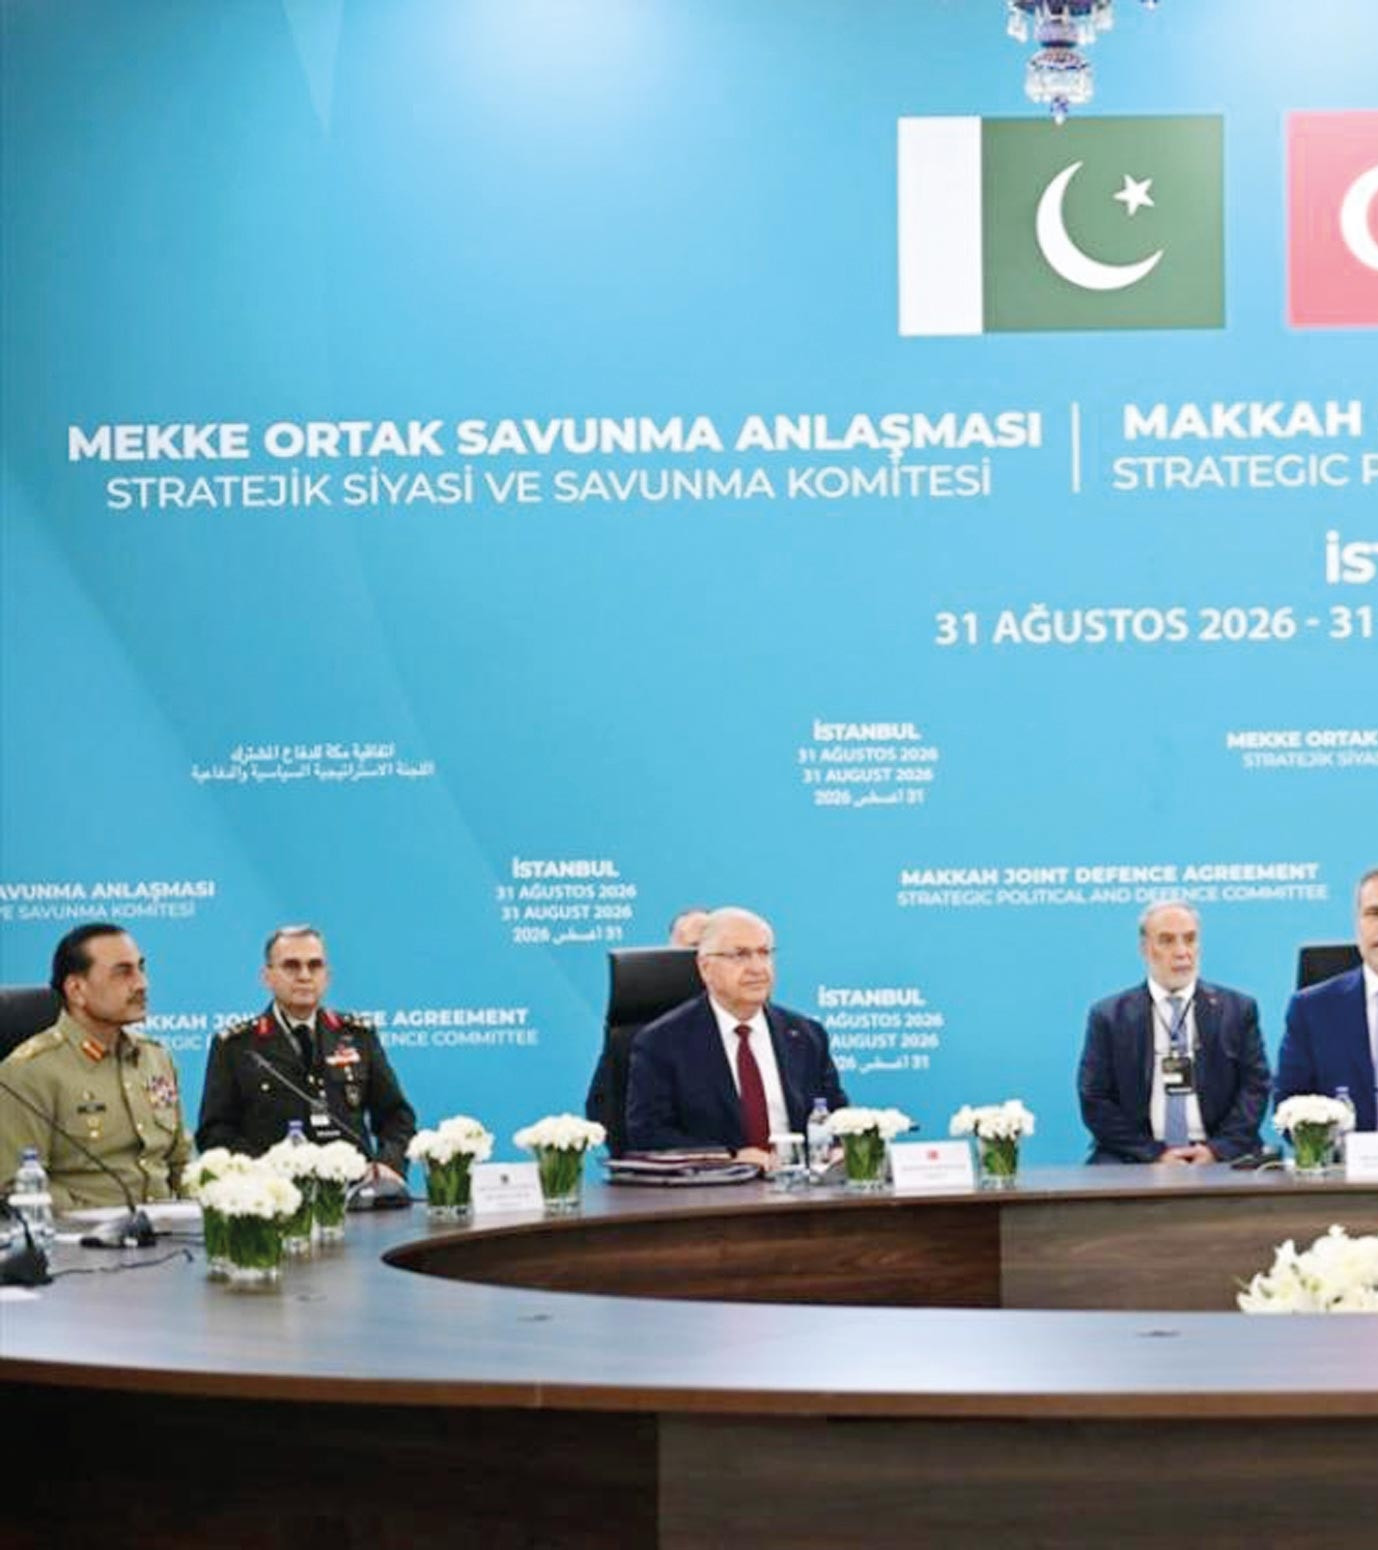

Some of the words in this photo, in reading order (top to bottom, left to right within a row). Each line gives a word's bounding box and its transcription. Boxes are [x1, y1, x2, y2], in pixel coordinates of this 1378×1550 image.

[1124, 401, 1362, 440] MAKKAH
[69, 423, 249, 461] MEKKE
[264, 420, 443, 457] ORTAK
[458, 416, 722, 454] SAVUNMA
[736, 412, 1041, 456] ANLAŞMASI
[1113, 454, 1349, 490] STRATEGIC
[107, 468, 332, 509] STRATEJİK
[344, 465, 473, 506] SİYASİ
[485, 471, 542, 503] VE
[555, 469, 775, 502] SAVUNMA
[788, 458, 991, 498] KOMİTESİ
[935, 612, 977, 645] 31
[993, 603, 1189, 644] AĞUSTOS
[1199, 607, 1297, 641] 2026
[1330, 606, 1372, 639] 31
[1227, 731, 1302, 749] MEKKE
[1304, 730, 1378, 747] ORTAK
[798, 748, 816, 764] 31
[900, 747, 939, 762] 2026
[803, 768, 821, 784] 31
[825, 768, 891, 782] AUGUST
[896, 767, 934, 782] 2026
[814, 789, 852, 805] 2026
[906, 788, 924, 804] 31
[900, 869, 999, 886] MAKKAH
[1004, 867, 1069, 885] JOINT
[1075, 865, 1177, 884] DEFENCE
[1184, 863, 1318, 881] AGREEMENT
[496, 885, 514, 901] 31
[599, 884, 637, 899] 2026
[898, 889, 993, 906] STRATEGIC
[998, 888, 1086, 905] POLITICAL
[1090, 887, 1131, 903] AND
[1135, 886, 1218, 902] DEFENCE
[1222, 884, 1328, 901] COMMITTEE
[18, 904, 108, 920] SAVUNMA
[502, 906, 520, 921] 31
[523, 906, 589, 920] AUGUST
[594, 904, 632, 920] 2026
[512, 926, 550, 943] 2026
[605, 926, 623, 940] 31
[391, 1007, 529, 1027] AGREEMENT
[904, 1012, 944, 1028] 2026
[431, 1028, 539, 1046] COMMITTEE
[830, 1033, 896, 1050] AUGUST
[901, 1033, 939, 1048] 2026
[912, 1055, 929, 1069] 31
